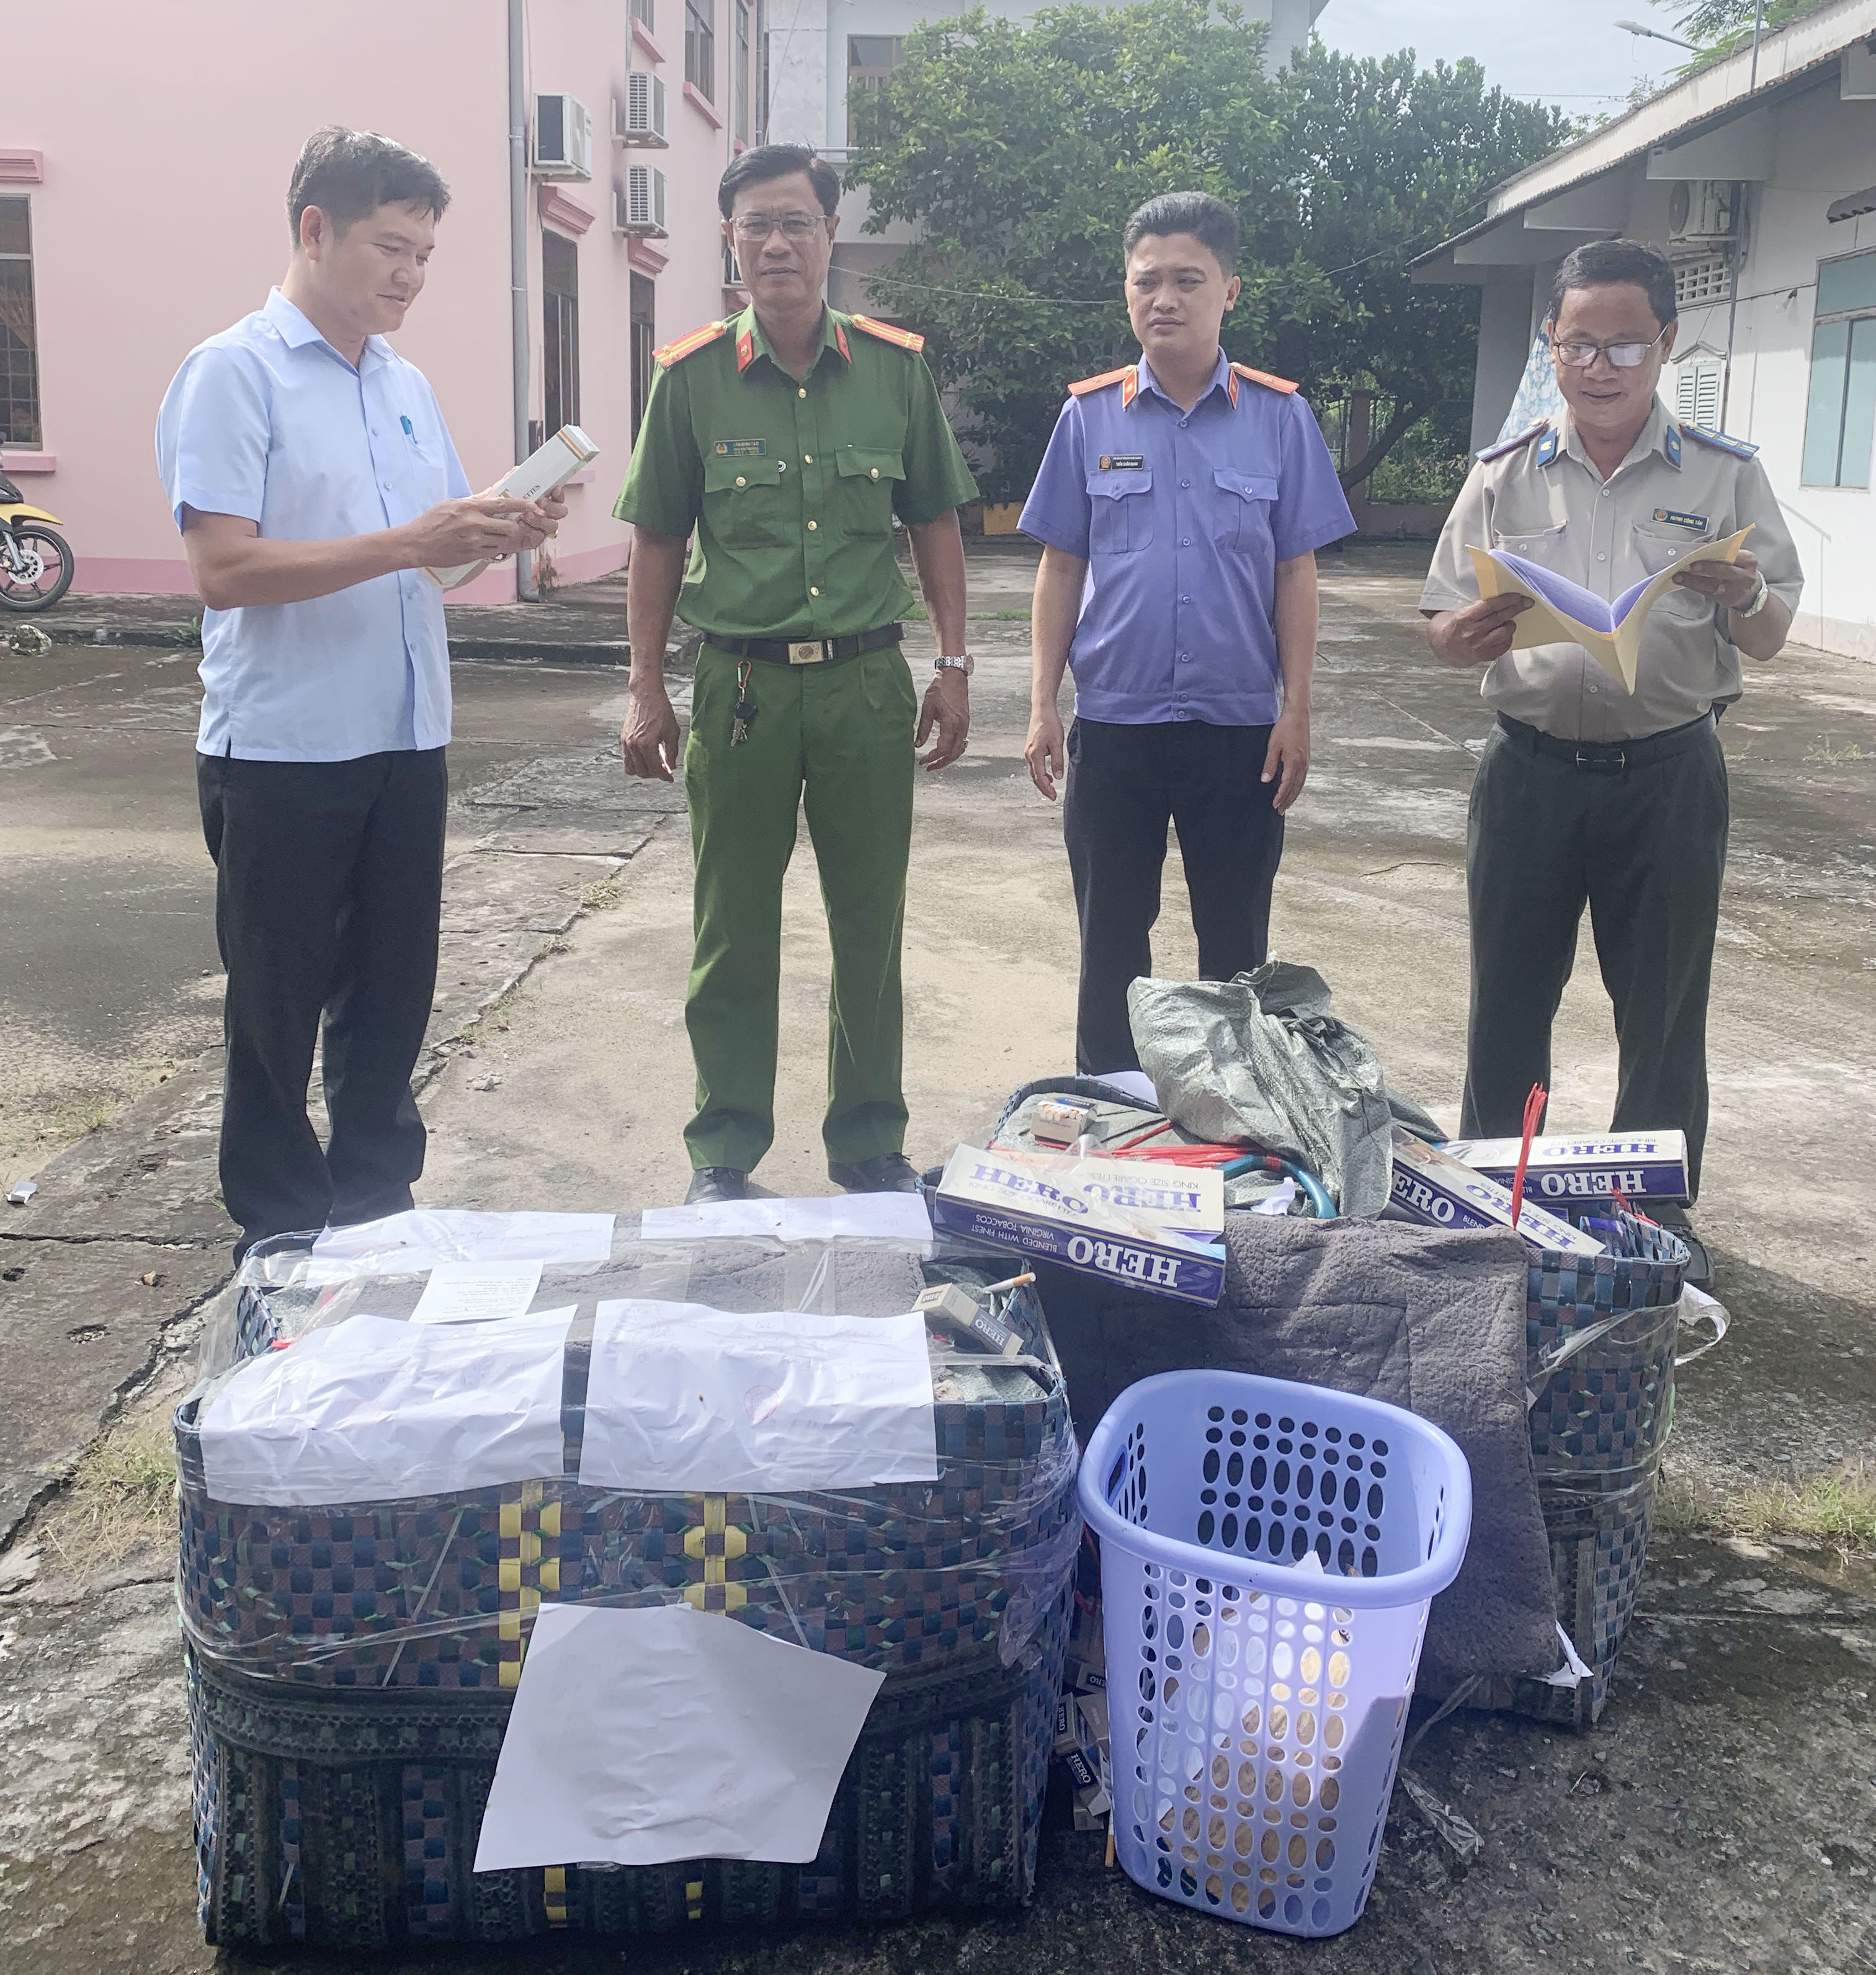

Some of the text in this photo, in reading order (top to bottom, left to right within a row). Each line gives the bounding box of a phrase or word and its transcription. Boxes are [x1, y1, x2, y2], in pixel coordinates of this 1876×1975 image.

[1542, 1143, 1658, 1156] HERO
[969, 1164, 1089, 1214] HERO
[1083, 1184, 1201, 1212] HERO
[1391, 1168, 1455, 1223] ERO
[1540, 1170, 1647, 1197] HERO
[976, 1214, 1055, 1241] VIRGINIA TOBACCOS
[1465, 1184, 1576, 1250] HERO
[970, 1224, 1058, 1252] BLENDED WITH FINEST
[1066, 1236, 1182, 1288] HERO
[975, 1317, 1006, 1347] HERO
[1071, 1754, 1091, 1783] HERO
